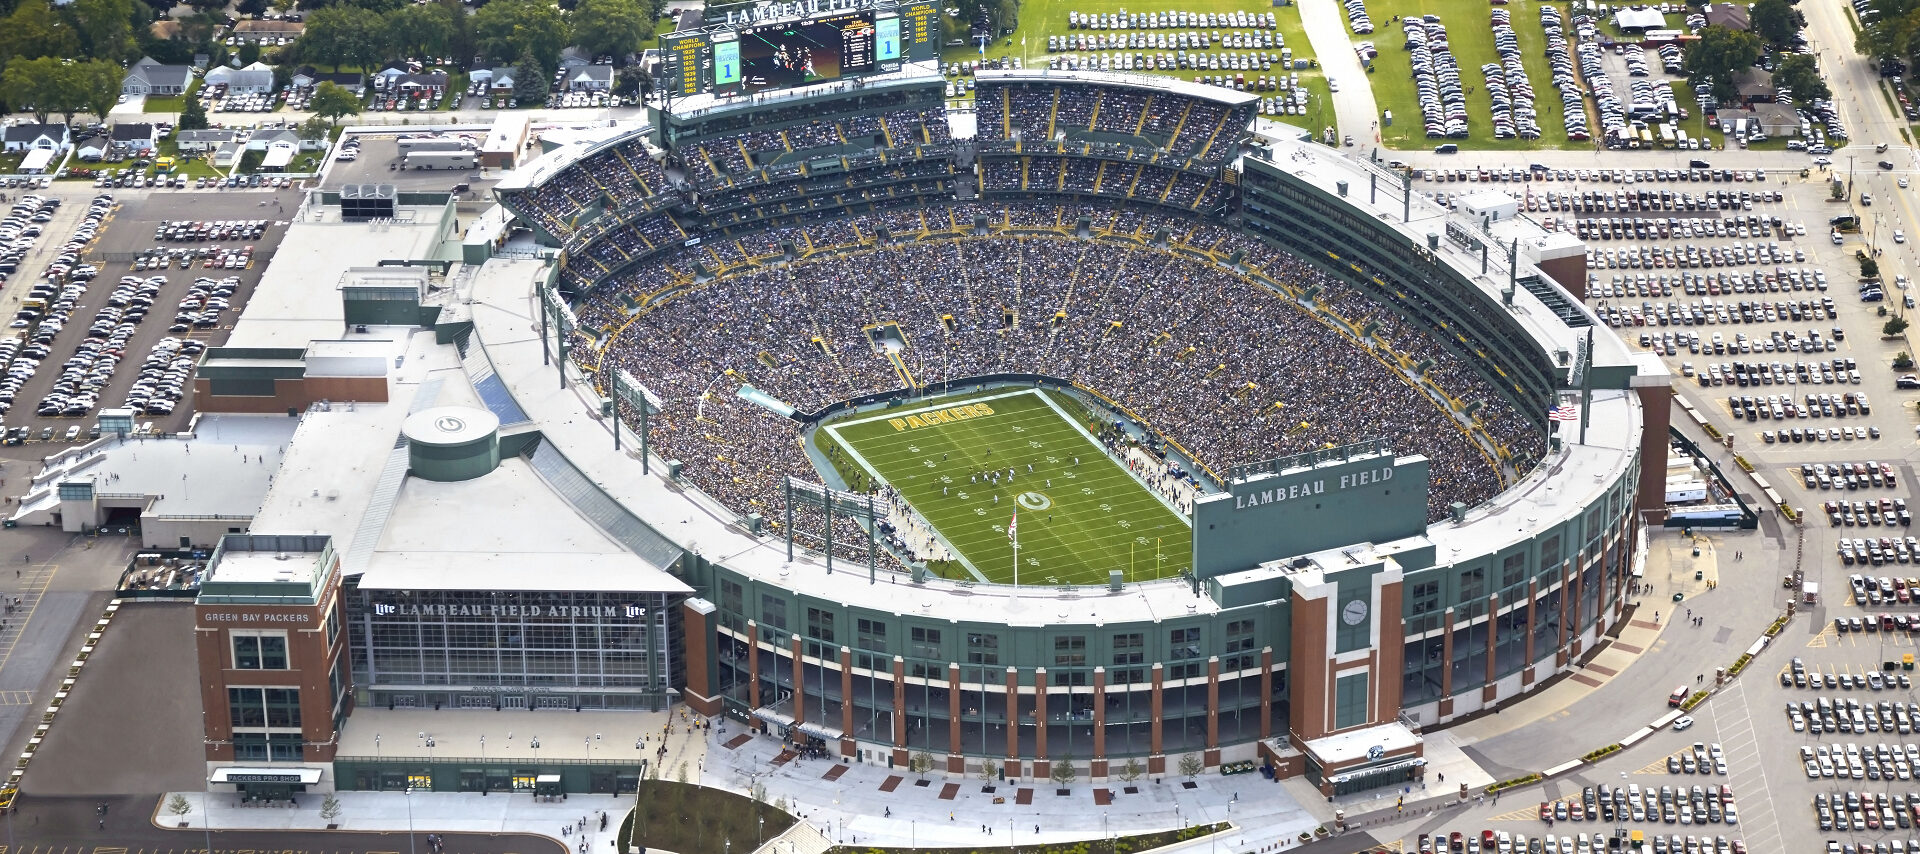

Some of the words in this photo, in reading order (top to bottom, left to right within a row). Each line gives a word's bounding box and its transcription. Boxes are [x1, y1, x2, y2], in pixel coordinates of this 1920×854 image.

[727, 0, 818, 24] LAMBEAU
[905, 9, 936, 17] CHAMPIONS
[672, 42, 705, 50] CHAMPIONS
[885, 41, 892, 54] 1
[724, 64, 732, 78] 1
[888, 403, 994, 432] PACKERS
[1236, 480, 1324, 509] LAMBEAU
[1340, 467, 1393, 489] FIELD
[376, 604, 395, 615] Lite
[400, 604, 482, 616] LAMBEAU
[490, 605, 540, 616] FIELD
[549, 606, 616, 617] ATRIUM
[626, 606, 646, 618] Lite
